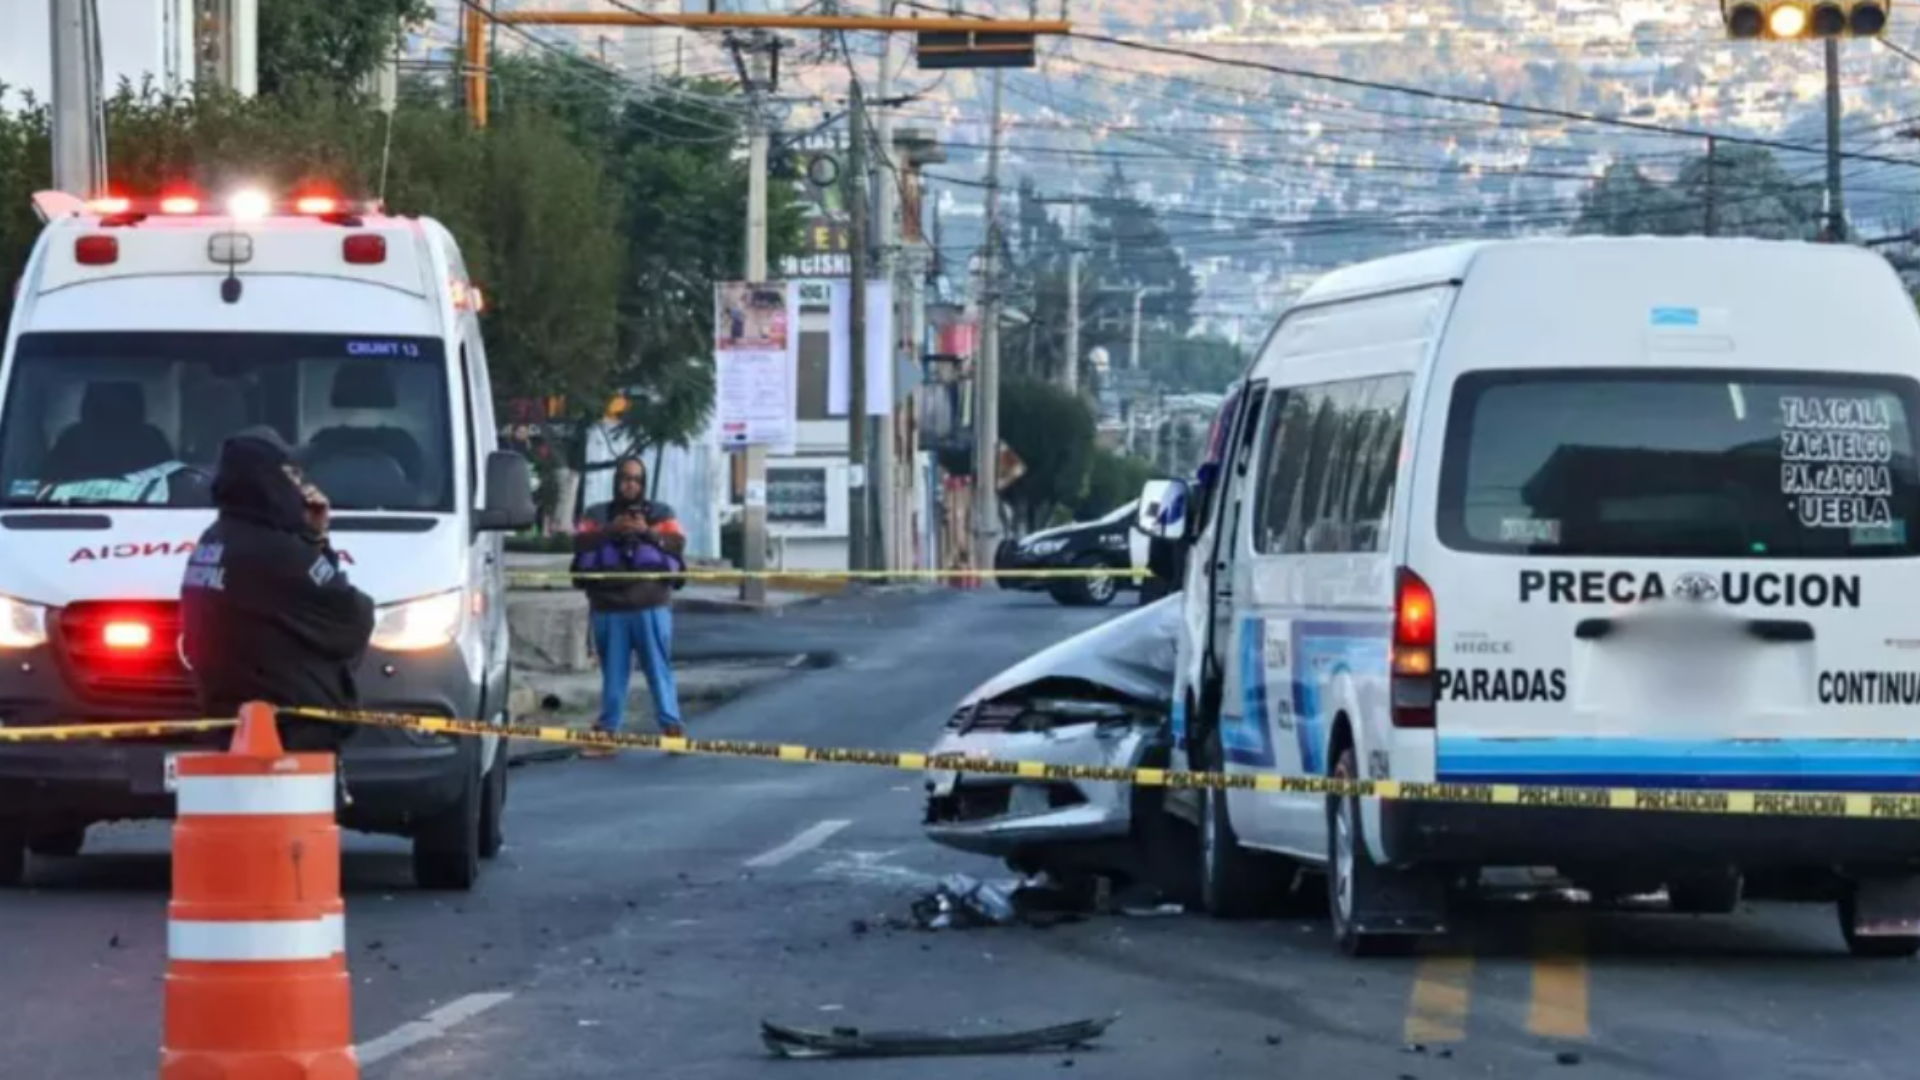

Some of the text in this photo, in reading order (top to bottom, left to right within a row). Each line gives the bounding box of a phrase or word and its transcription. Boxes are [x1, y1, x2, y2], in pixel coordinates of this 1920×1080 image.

[1779, 396, 1890, 430] TLAXCALA
[1781, 430, 1892, 462] ZACATELCO
[1788, 495, 1892, 528] UEBLA
[1518, 570, 1861, 608] PRECA UCION
[1437, 667, 1567, 702] PARADAS
